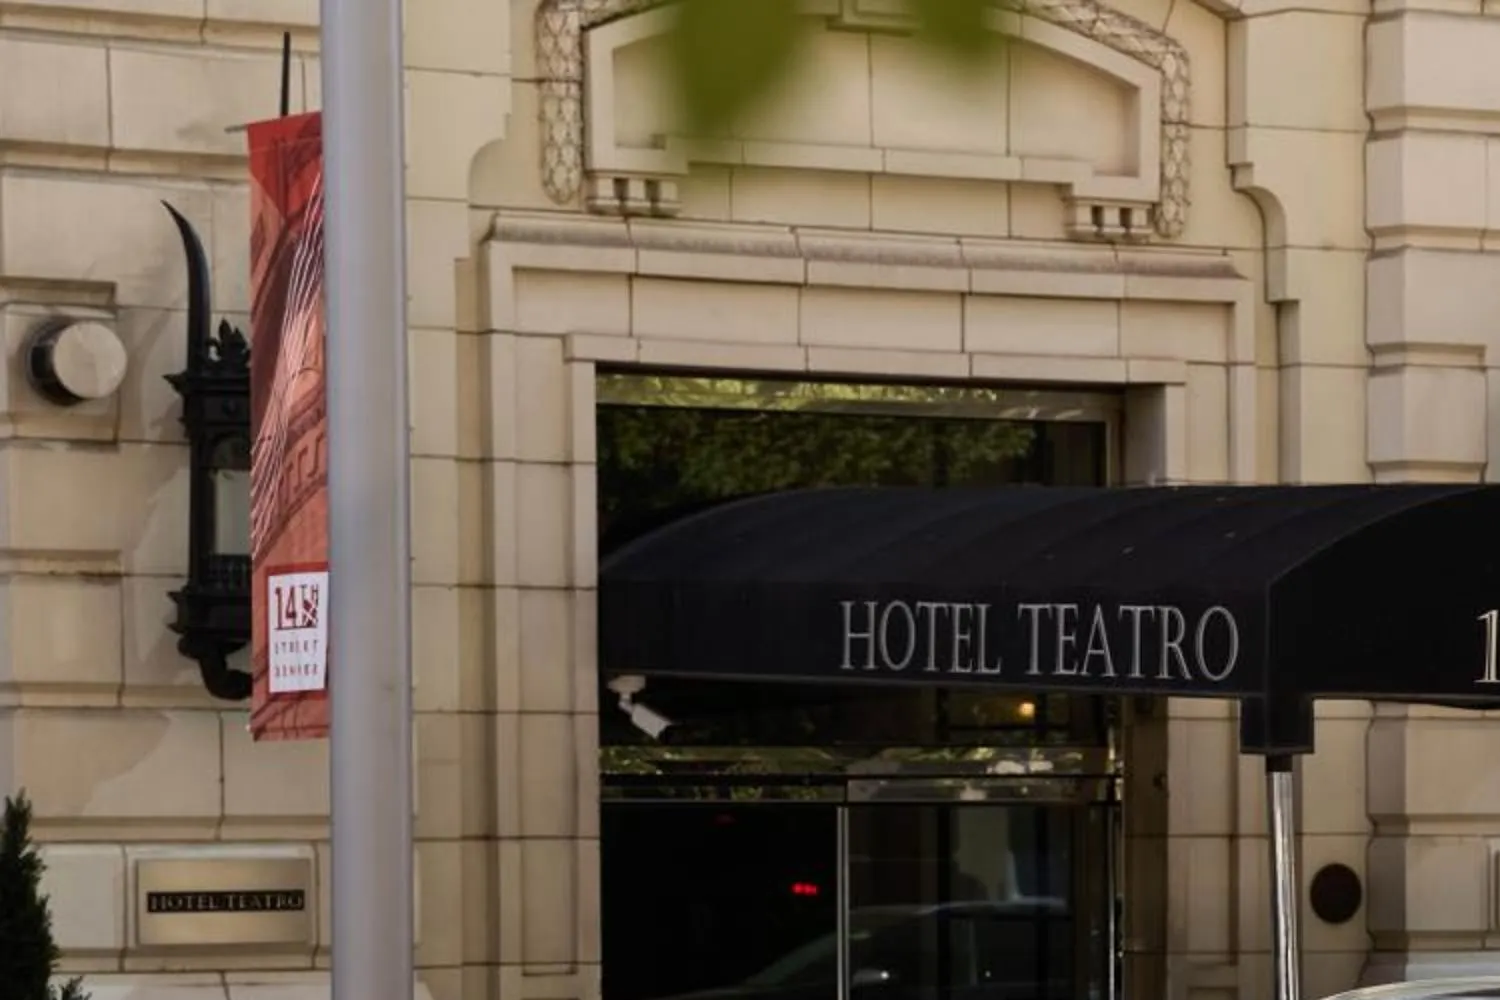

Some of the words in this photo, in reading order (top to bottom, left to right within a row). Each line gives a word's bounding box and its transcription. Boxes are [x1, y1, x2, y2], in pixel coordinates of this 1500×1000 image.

[840, 600, 1000, 673] HOTEL
[1018, 604, 1239, 681] TEATRO
[151, 896, 223, 910] HOTEL
[227, 895, 303, 909] TEATRO
